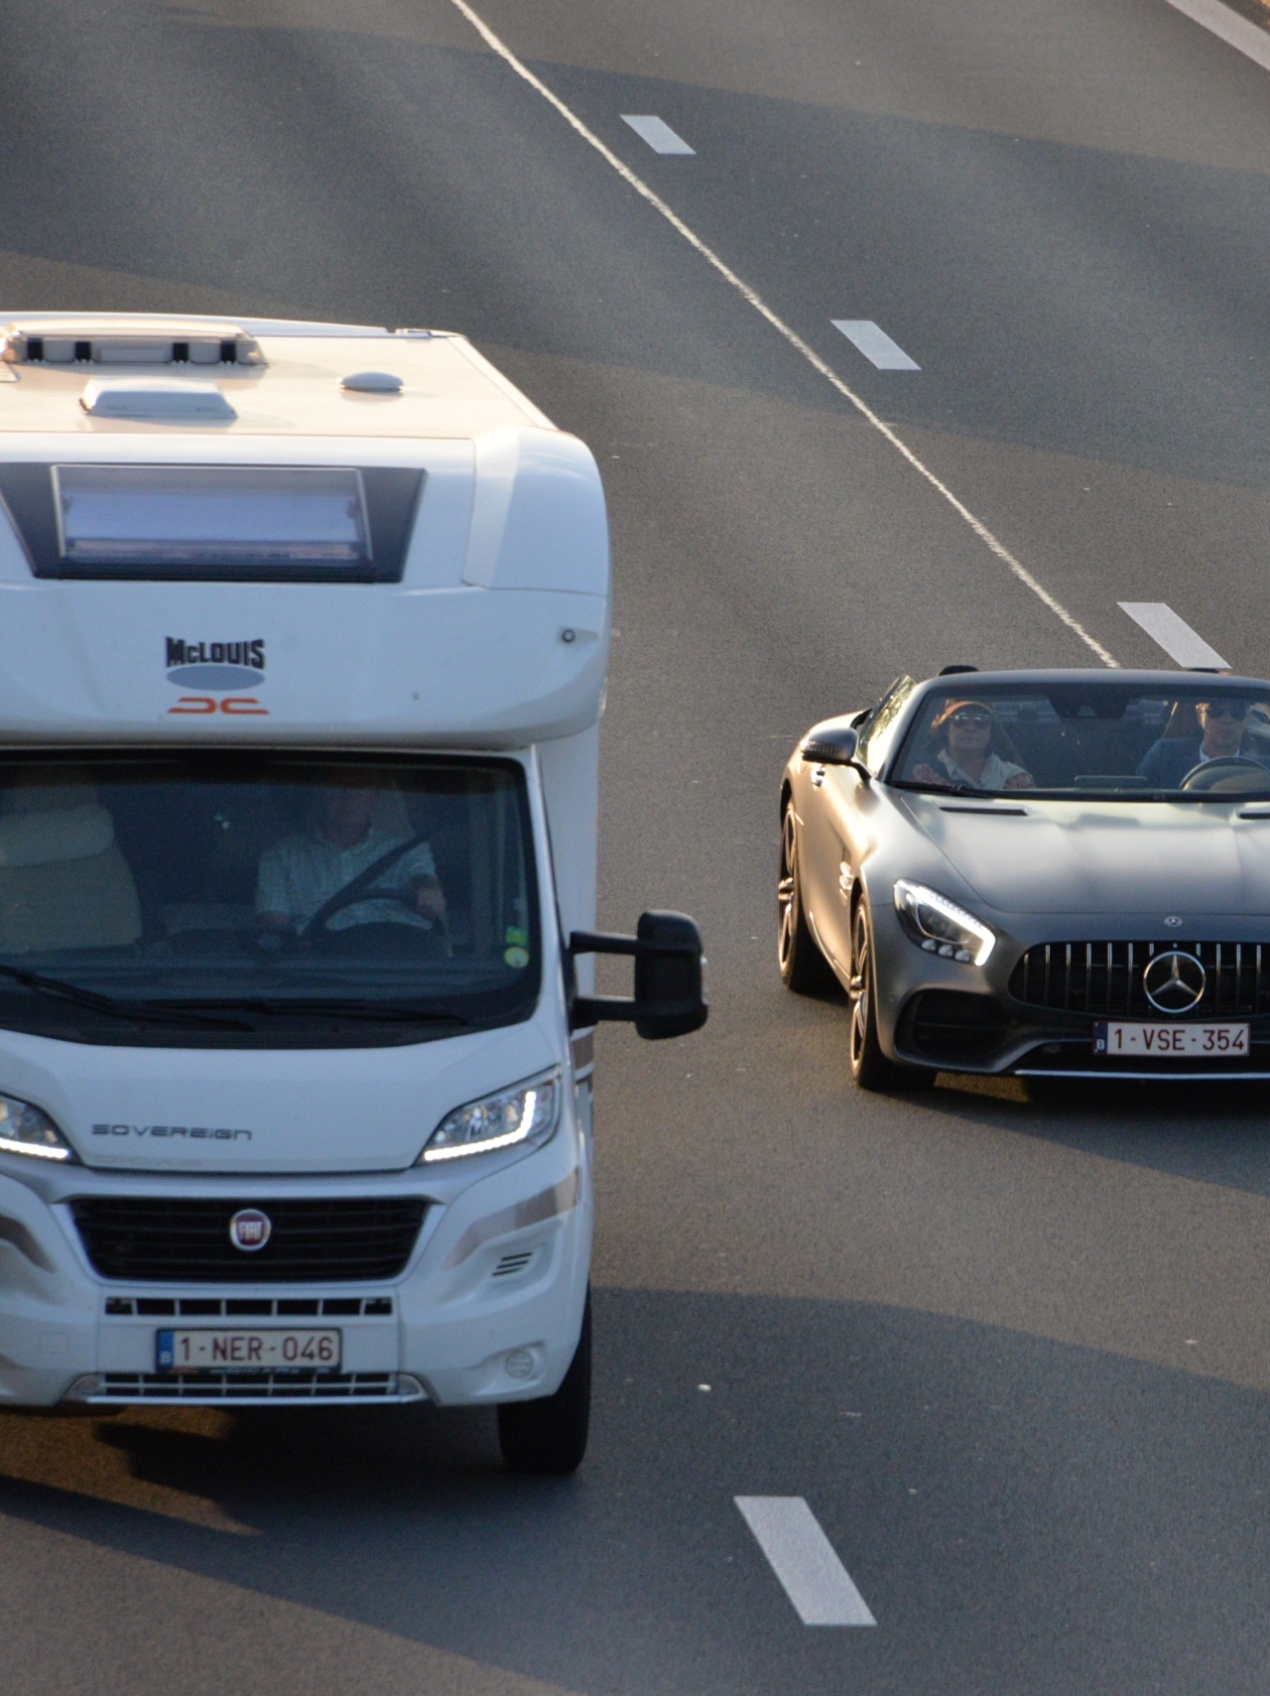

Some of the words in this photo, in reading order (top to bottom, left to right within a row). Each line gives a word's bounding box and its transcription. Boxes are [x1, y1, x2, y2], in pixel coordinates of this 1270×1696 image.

[1114, 1028, 1245, 1051] 1-VSE-354
[238, 1220, 263, 1241] FIAT
[180, 1336, 335, 1362] 1-NER-046
